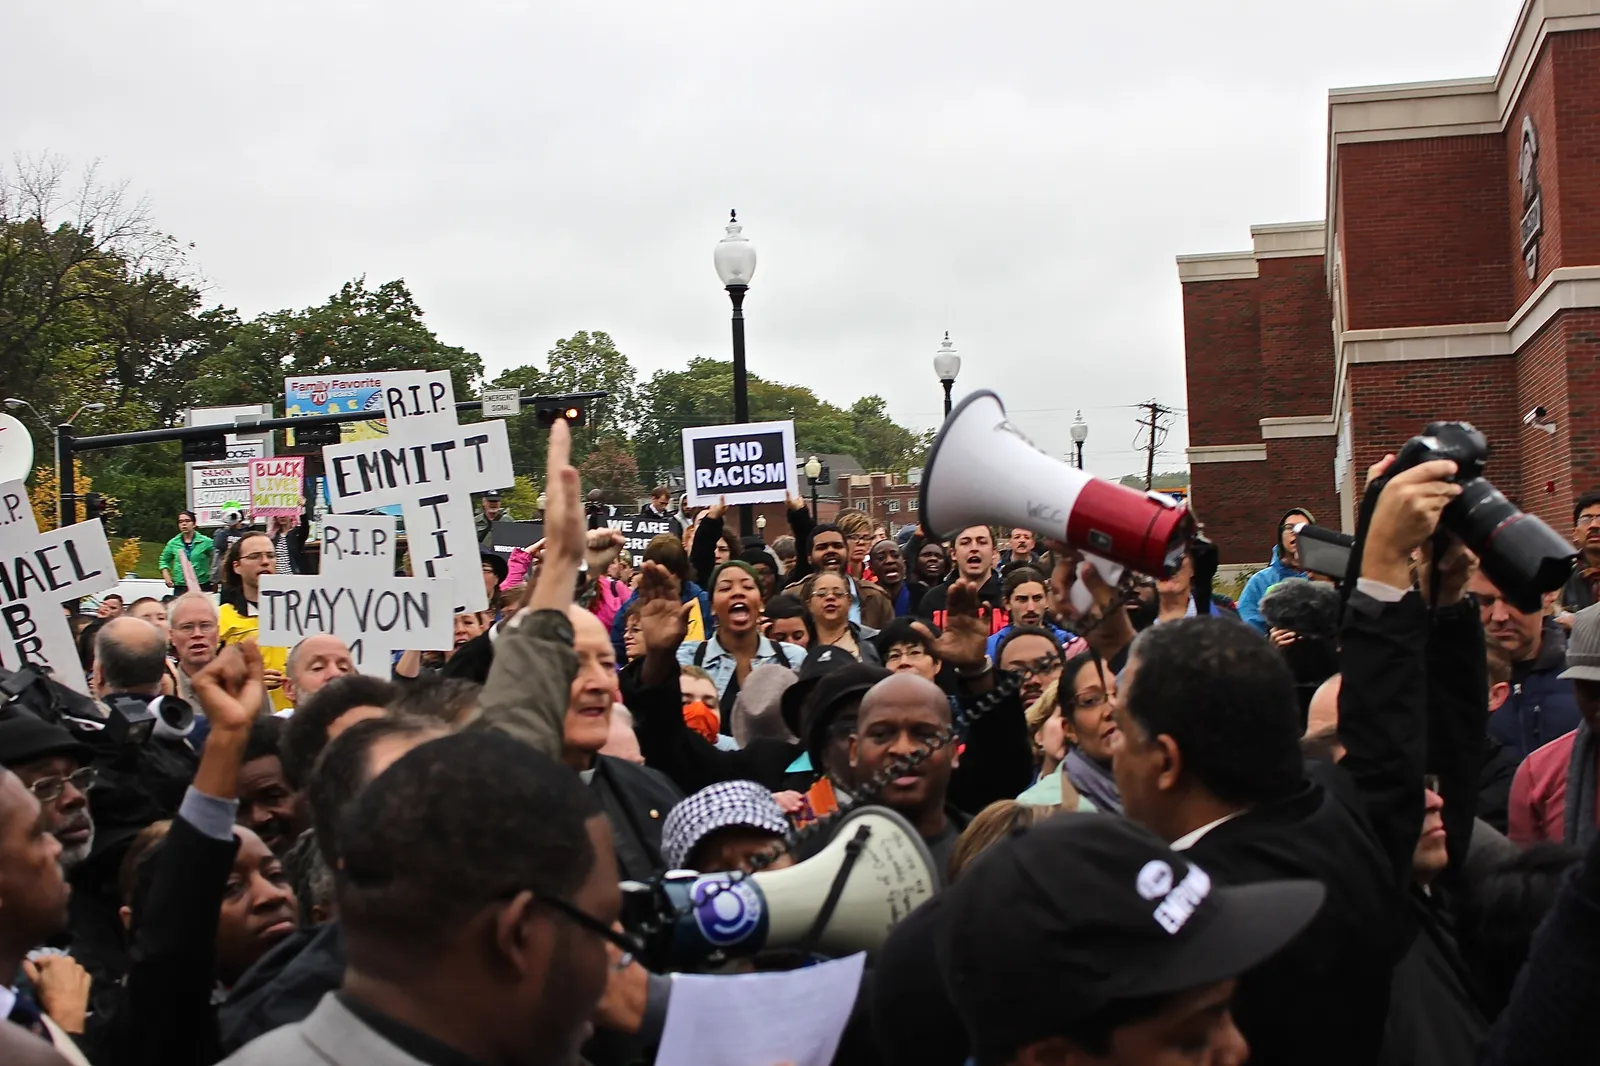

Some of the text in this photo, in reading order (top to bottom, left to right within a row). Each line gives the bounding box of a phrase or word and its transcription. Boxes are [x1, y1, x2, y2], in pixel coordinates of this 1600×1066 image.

[291, 381, 330, 392] Family
[312, 392, 327, 403] 70
[386, 382, 447, 420] R.I.P.
[226, 448, 256, 458] oost
[714, 441, 763, 464] END
[255, 461, 301, 477] BLACK
[332, 434, 489, 498] EMMITT
[696, 462, 786, 488] RACISM
[256, 478, 299, 492] LIVES
[197, 489, 250, 504] SUBWA
[253, 493, 300, 507] MATTER
[606, 519, 670, 534] WE ARE
[323, 525, 388, 560] R.I.P.
[261, 587, 430, 636] TRAYVON
